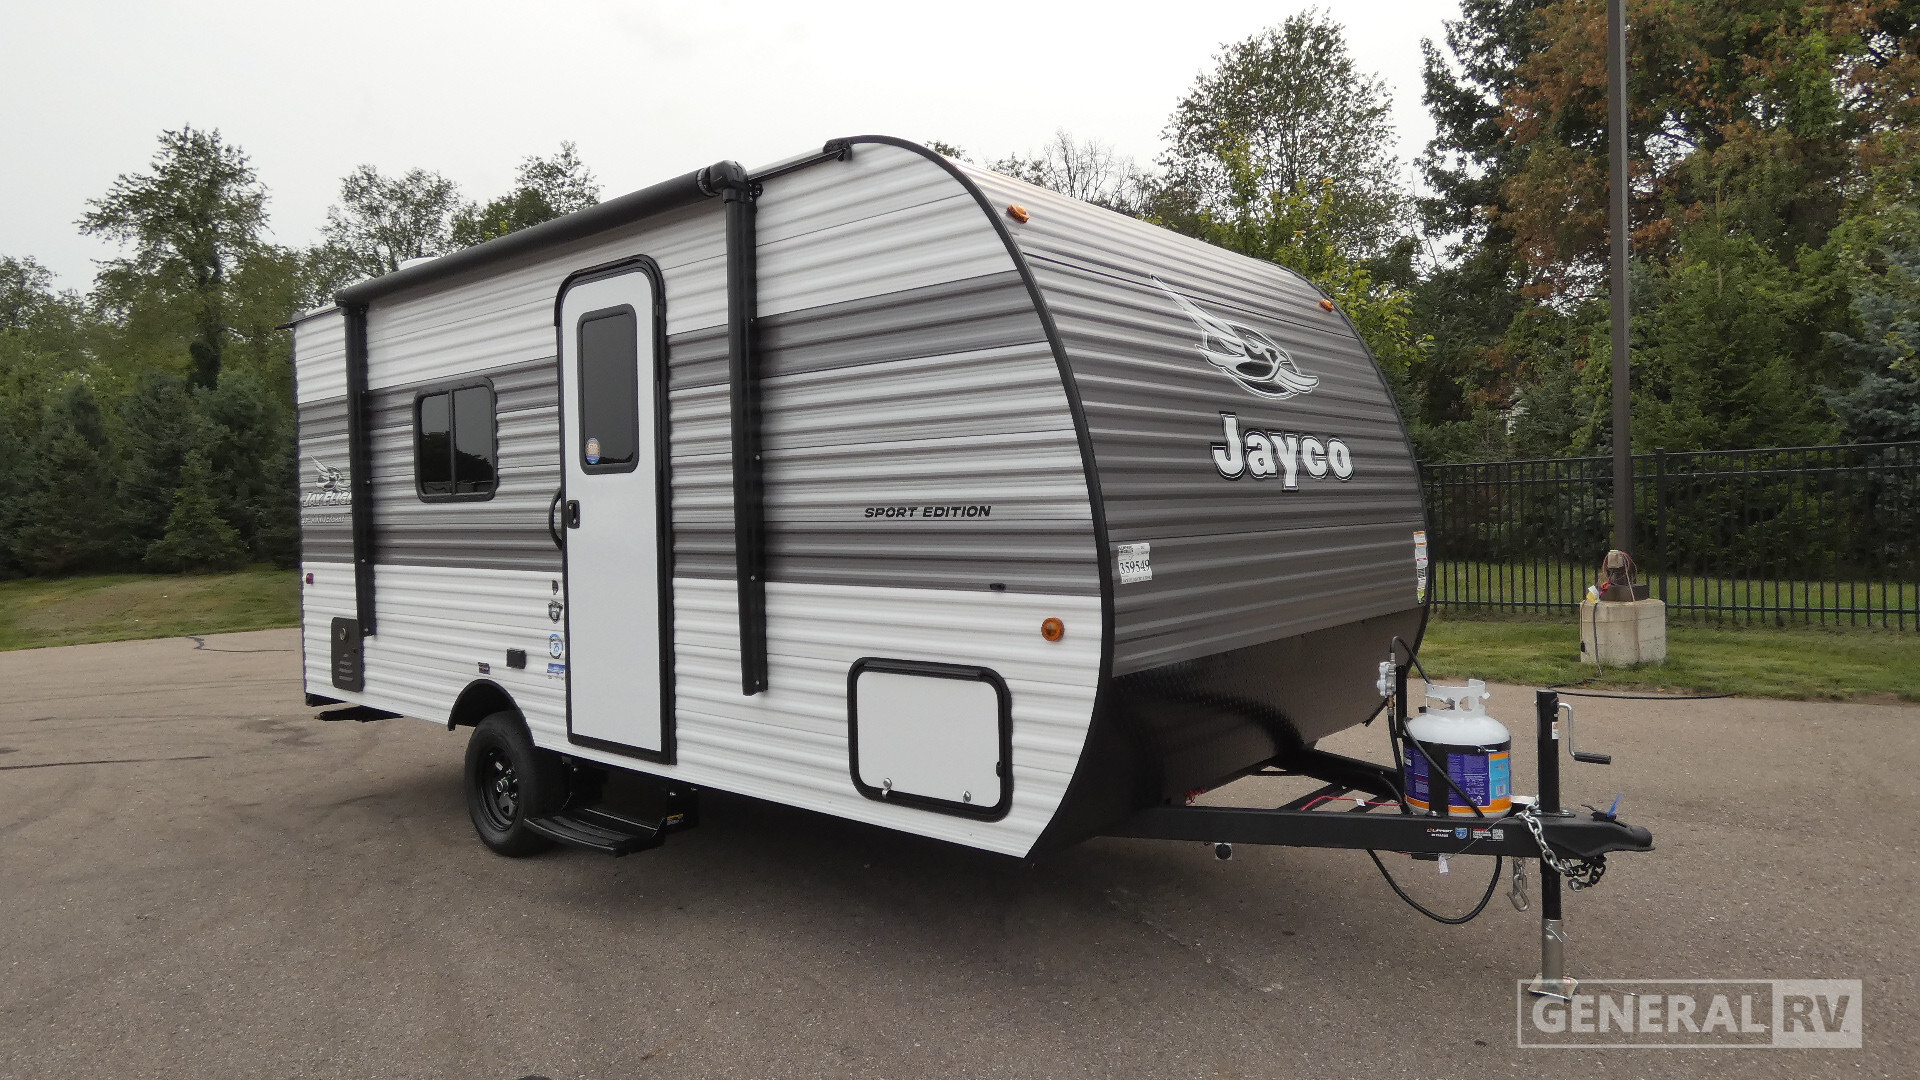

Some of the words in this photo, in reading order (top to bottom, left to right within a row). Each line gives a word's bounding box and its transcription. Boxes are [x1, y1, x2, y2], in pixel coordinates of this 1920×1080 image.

[1211, 411, 1354, 492] Jayco
[864, 506, 918, 518] SPORT
[922, 505, 991, 518] EDITION
[1120, 560, 1150, 574] 359549
